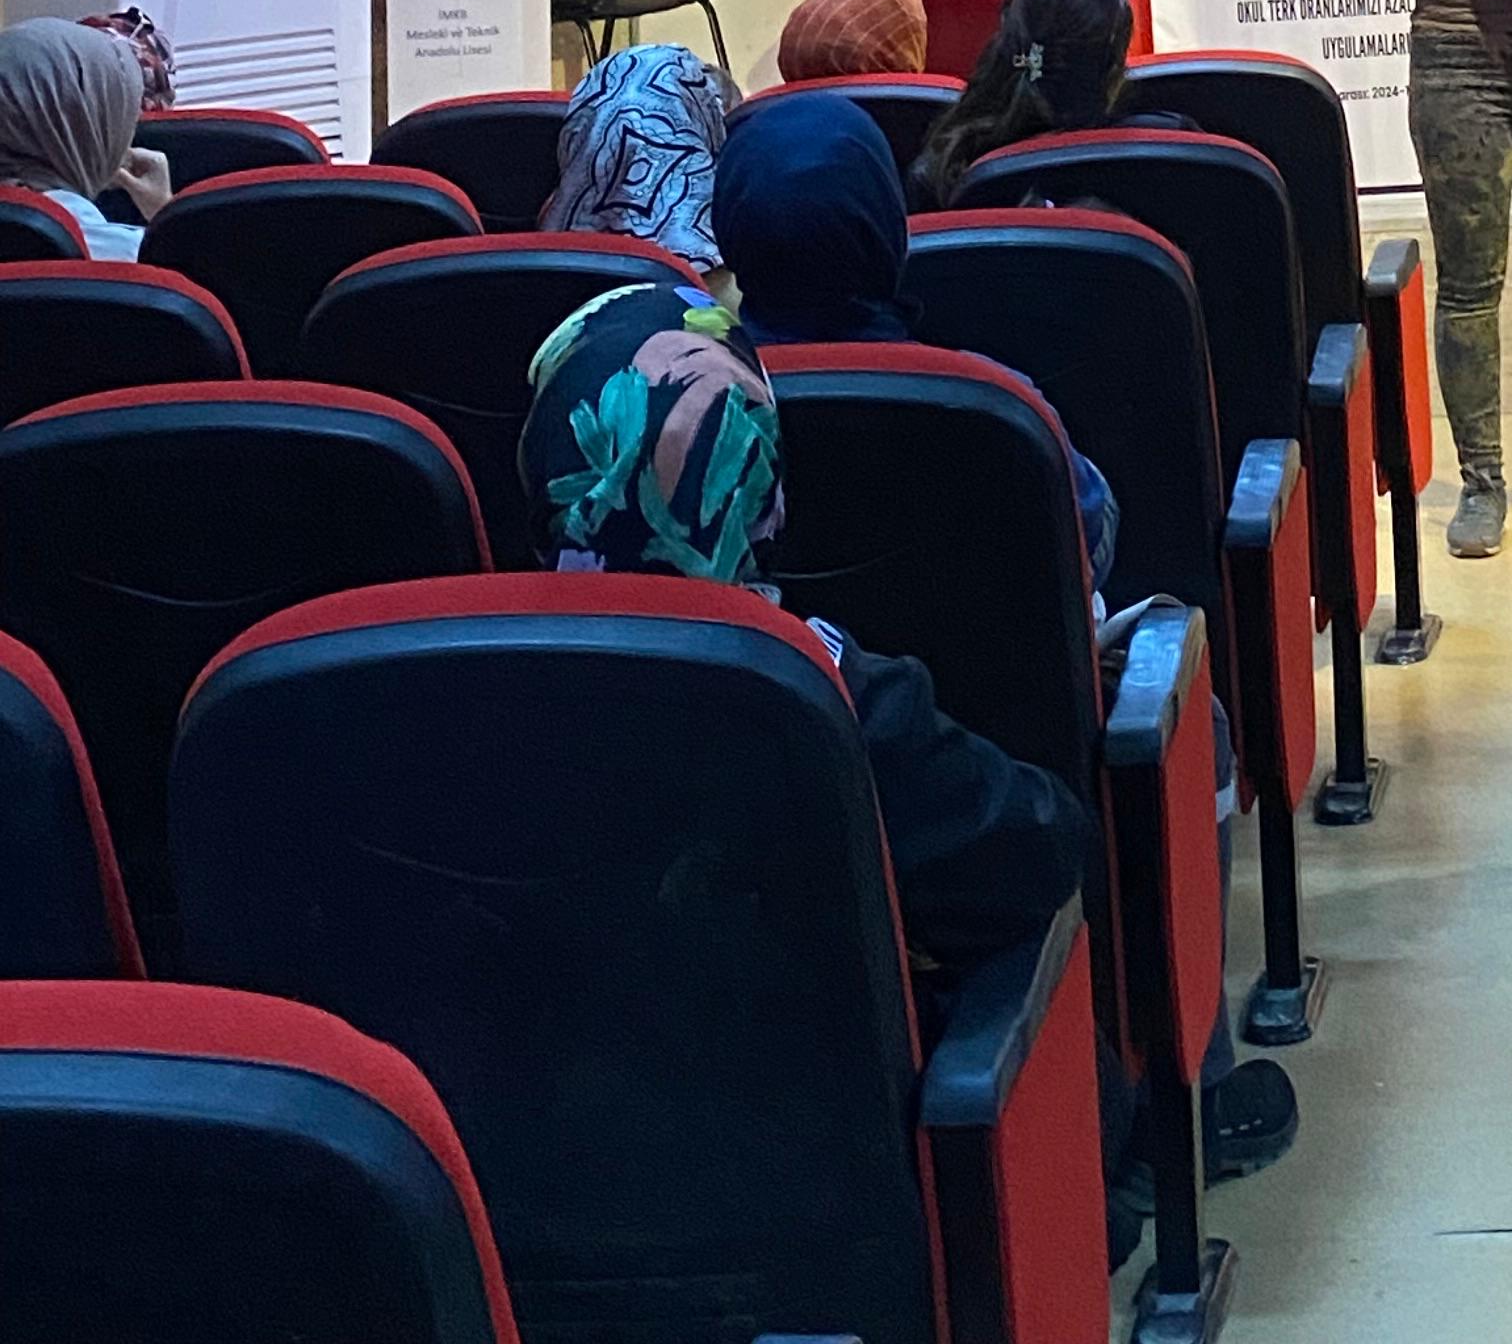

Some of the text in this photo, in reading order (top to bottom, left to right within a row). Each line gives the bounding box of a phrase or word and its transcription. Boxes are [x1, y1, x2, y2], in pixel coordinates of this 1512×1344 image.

[1237, 0, 1267, 23] OKUL
[406, 25, 500, 41] Mesleki ve Teknik
[415, 43, 492, 58] Anadolu Lisesi
